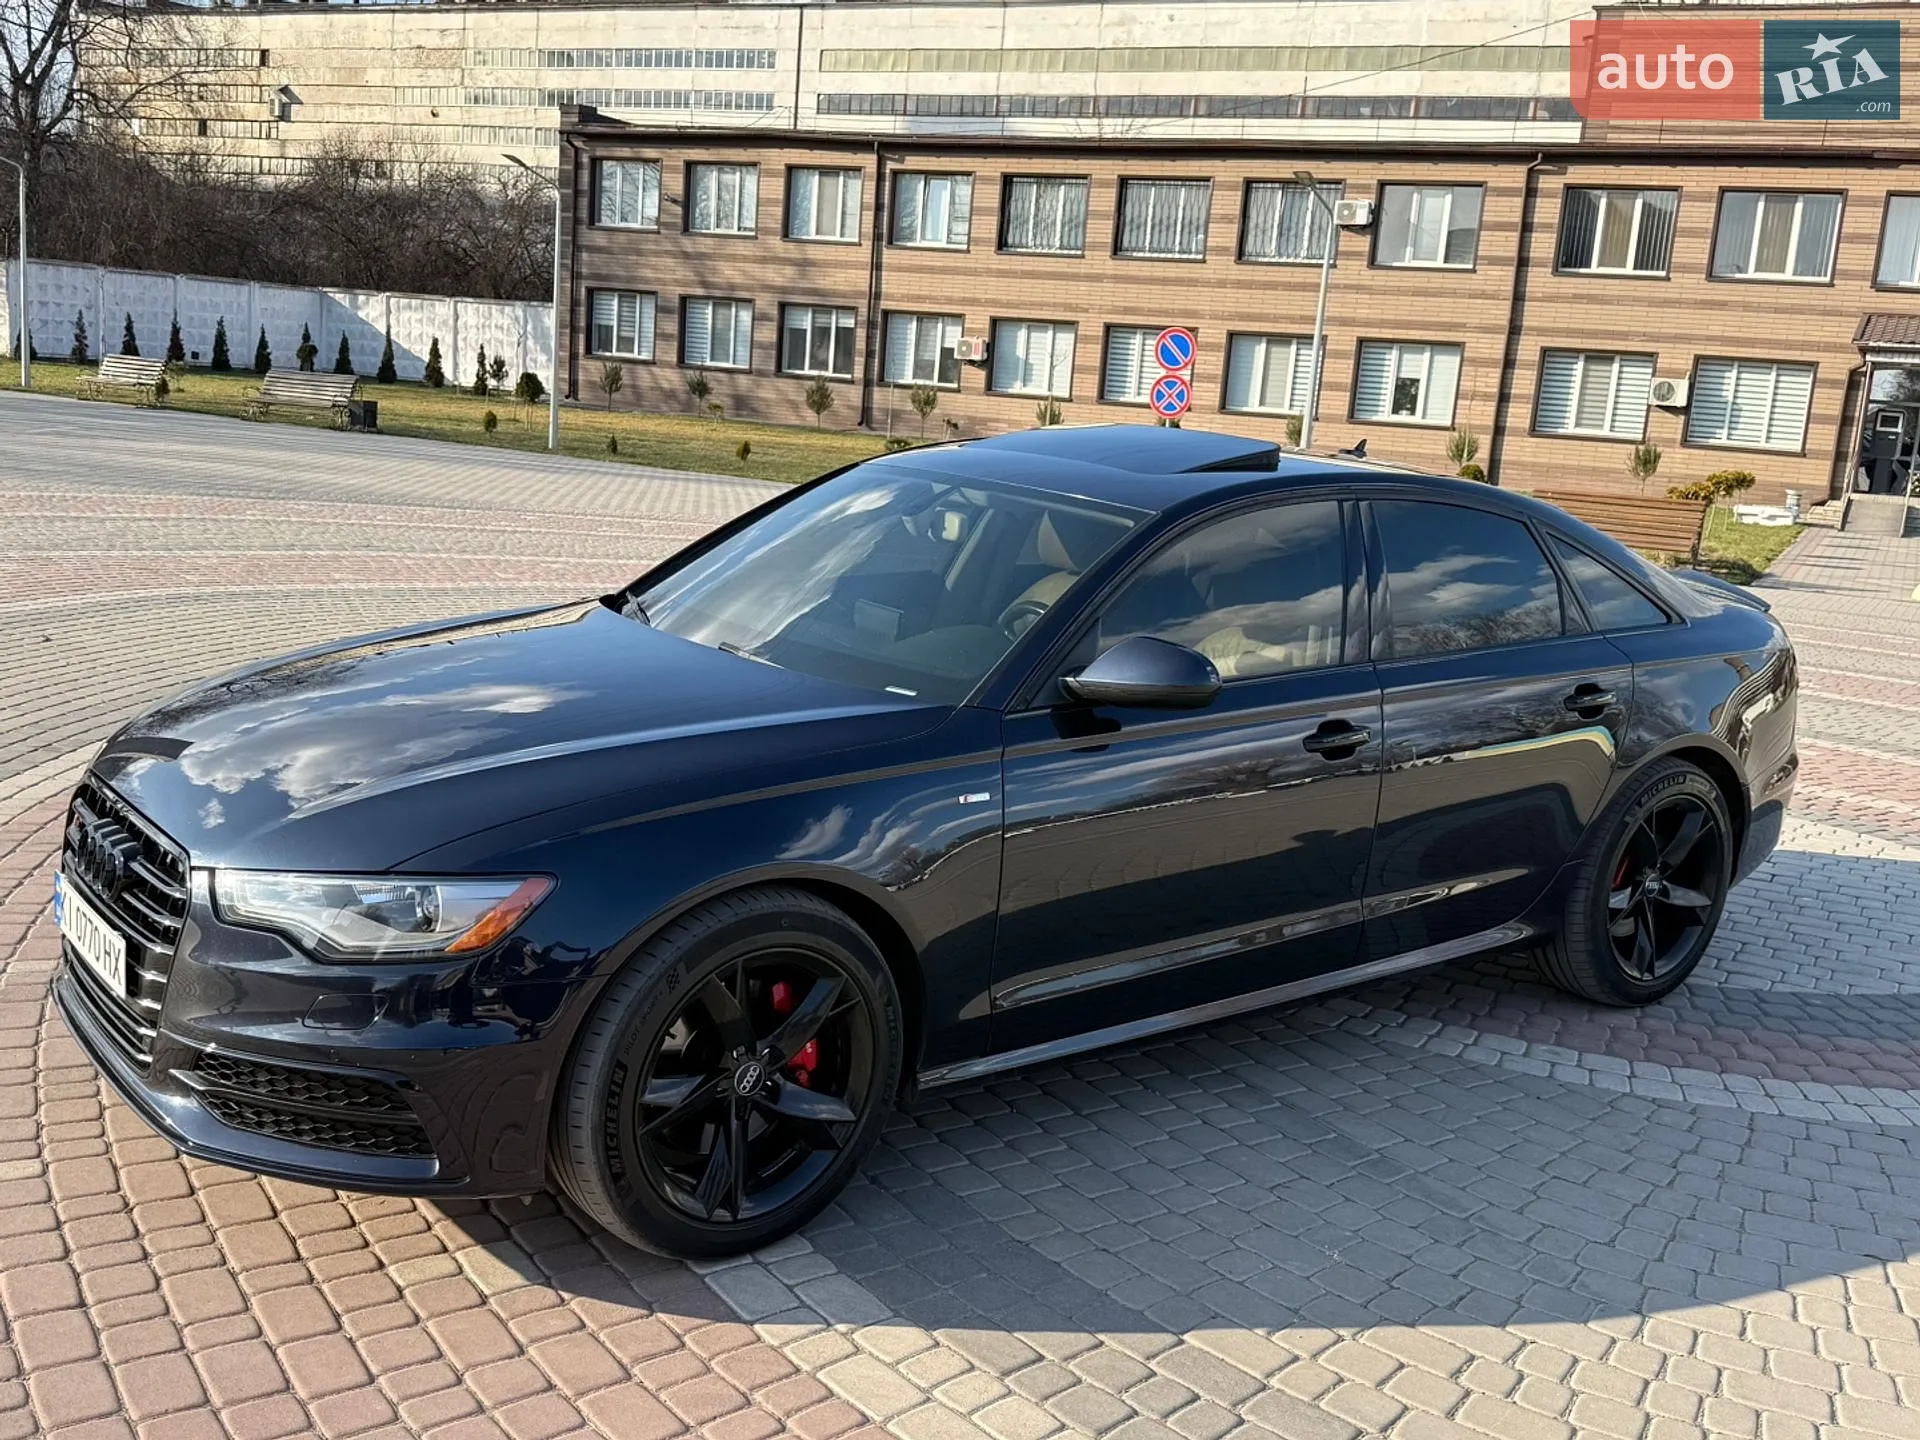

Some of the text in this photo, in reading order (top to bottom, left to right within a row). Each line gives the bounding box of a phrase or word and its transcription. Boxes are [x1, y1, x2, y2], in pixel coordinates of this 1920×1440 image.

[76, 906, 101, 963] 0770
[103, 933, 123, 985] HX
[605, 1065, 625, 1178] MICHELIN
